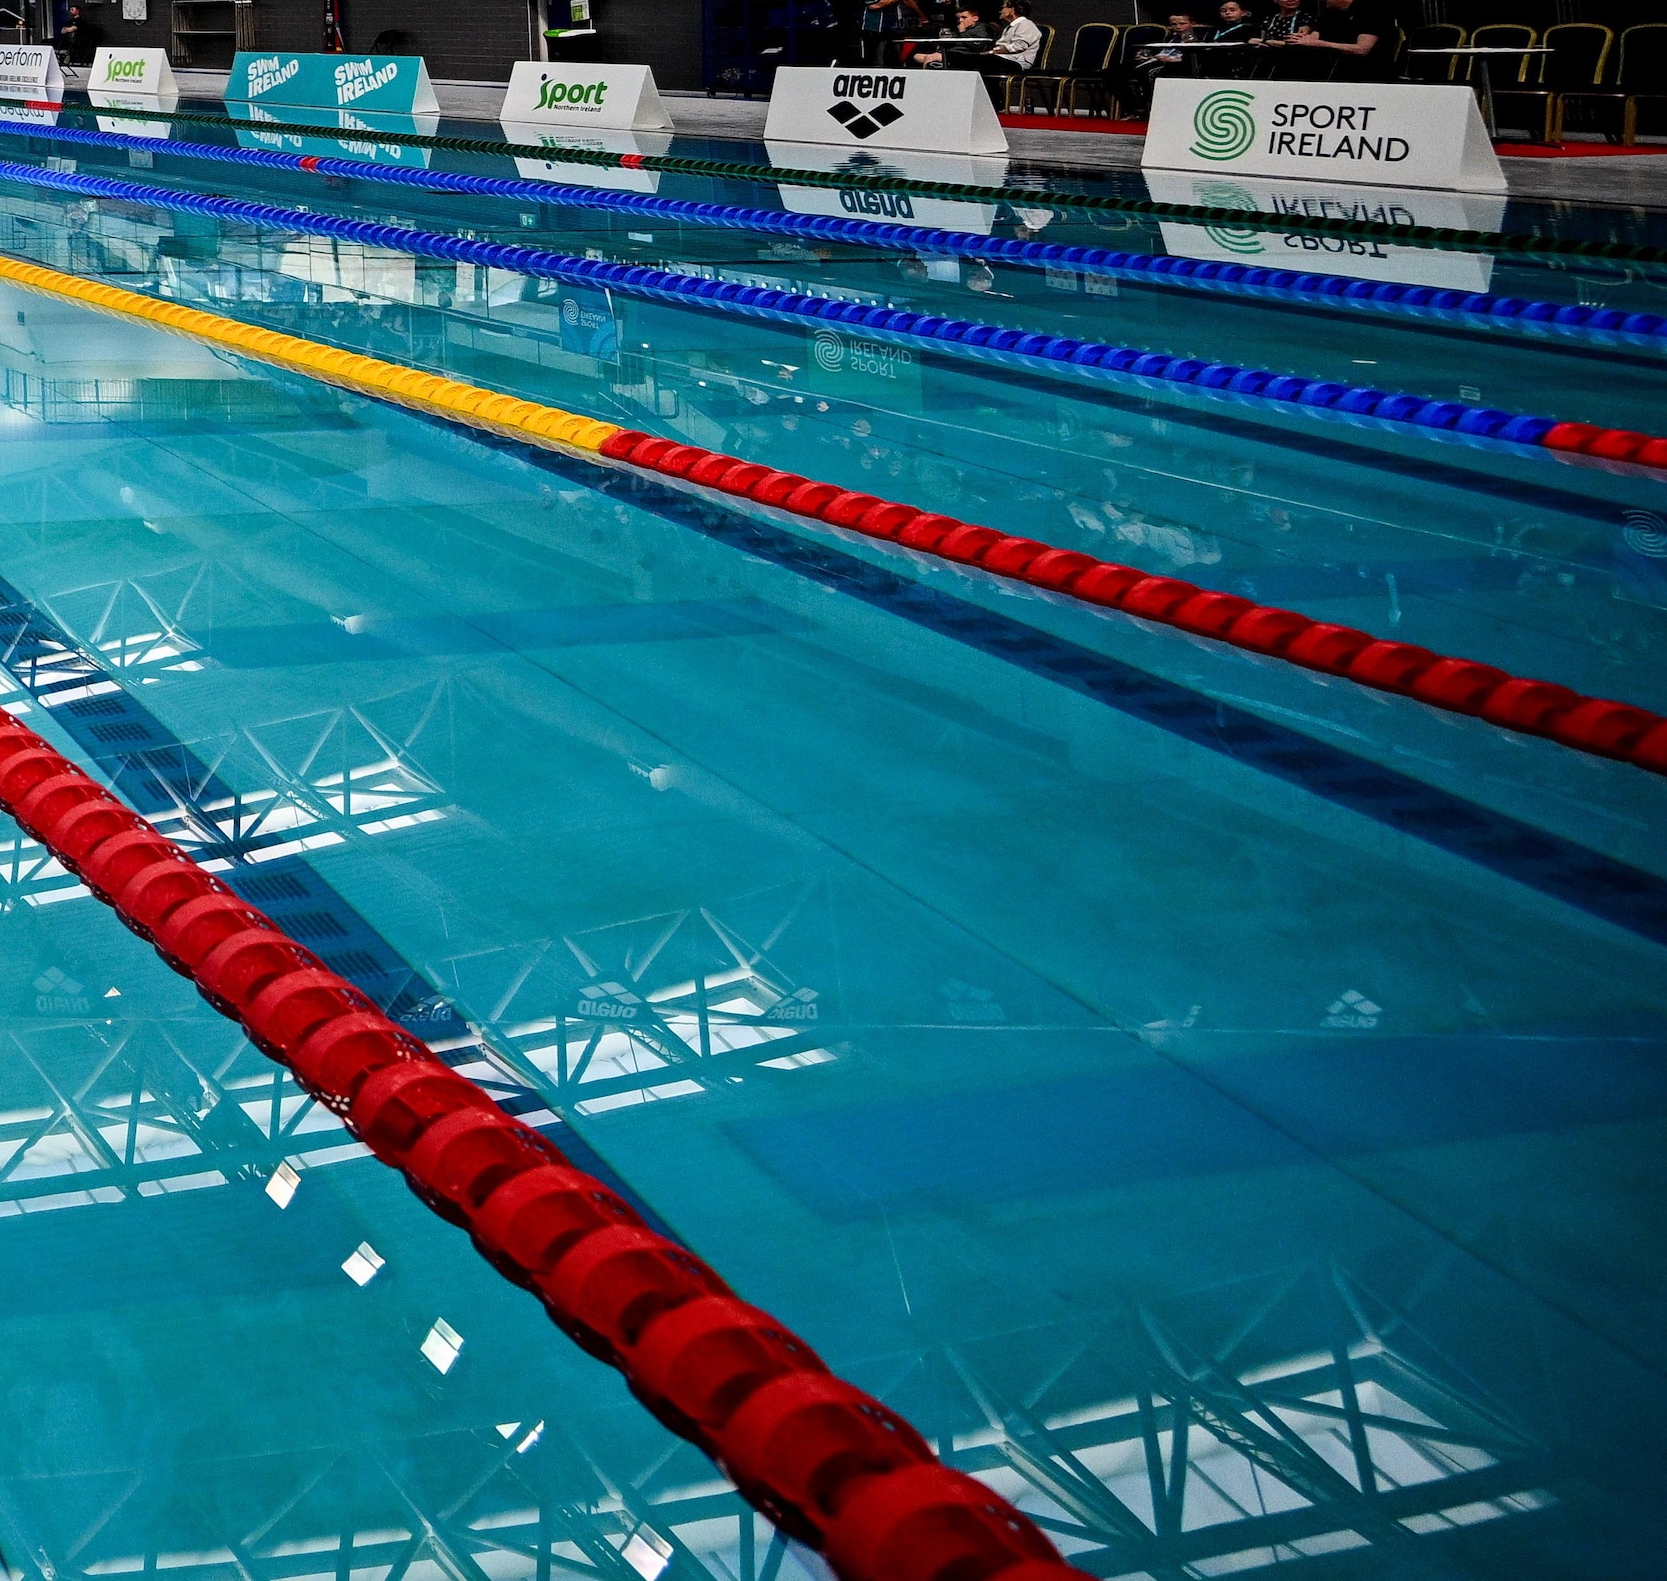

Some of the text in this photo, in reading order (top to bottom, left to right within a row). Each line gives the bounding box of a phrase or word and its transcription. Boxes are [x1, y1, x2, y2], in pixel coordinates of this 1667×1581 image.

[248, 56, 279, 83] SWIM
[248, 60, 299, 98] IRELAND
[334, 59, 373, 88] SWIM
[337, 63, 398, 106] IRELAND
[832, 74, 906, 100] arena
[553, 104, 601, 113] Northern Ireland
[1271, 103, 1376, 131] SPORT
[1268, 131, 1410, 162] IRELAND
